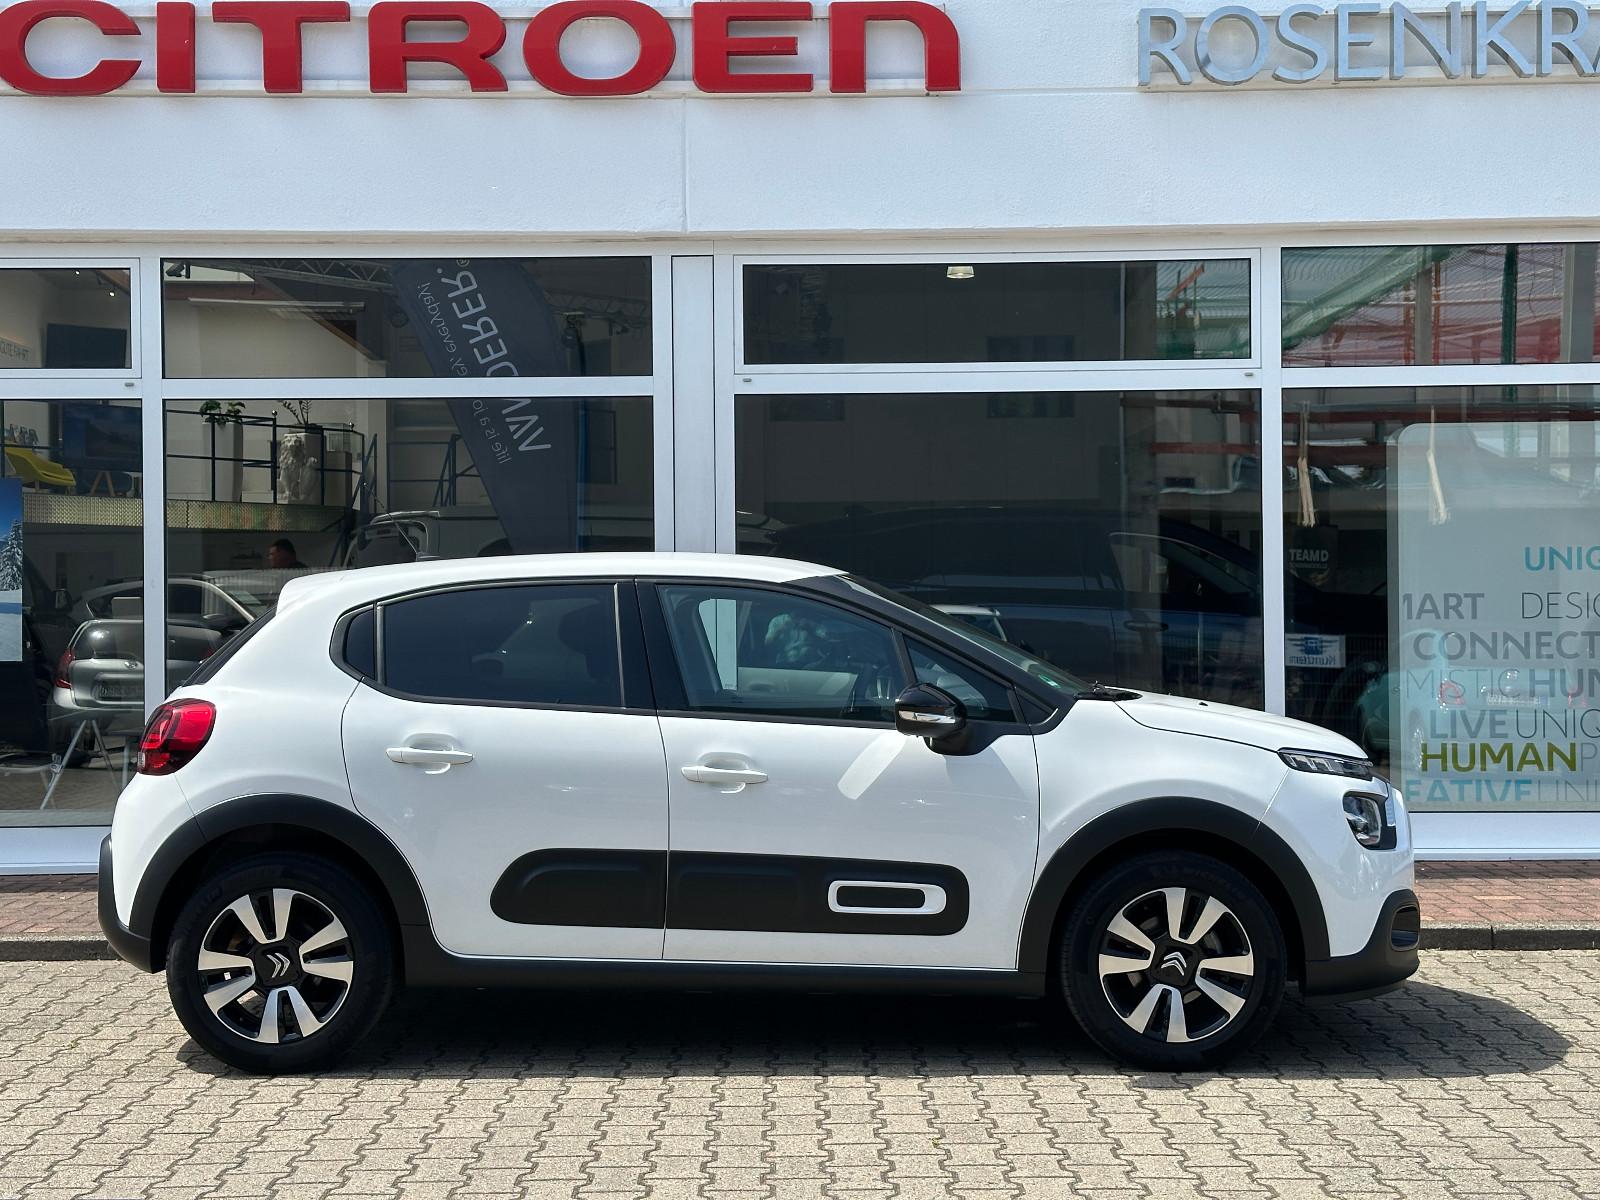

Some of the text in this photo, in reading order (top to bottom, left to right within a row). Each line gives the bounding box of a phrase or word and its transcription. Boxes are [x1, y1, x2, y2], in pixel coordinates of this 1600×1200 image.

[1138, 0, 1600, 86] ROSENKR
[1521, 591, 1600, 619] DESI
[1421, 742, 1576, 772] HUMAN
